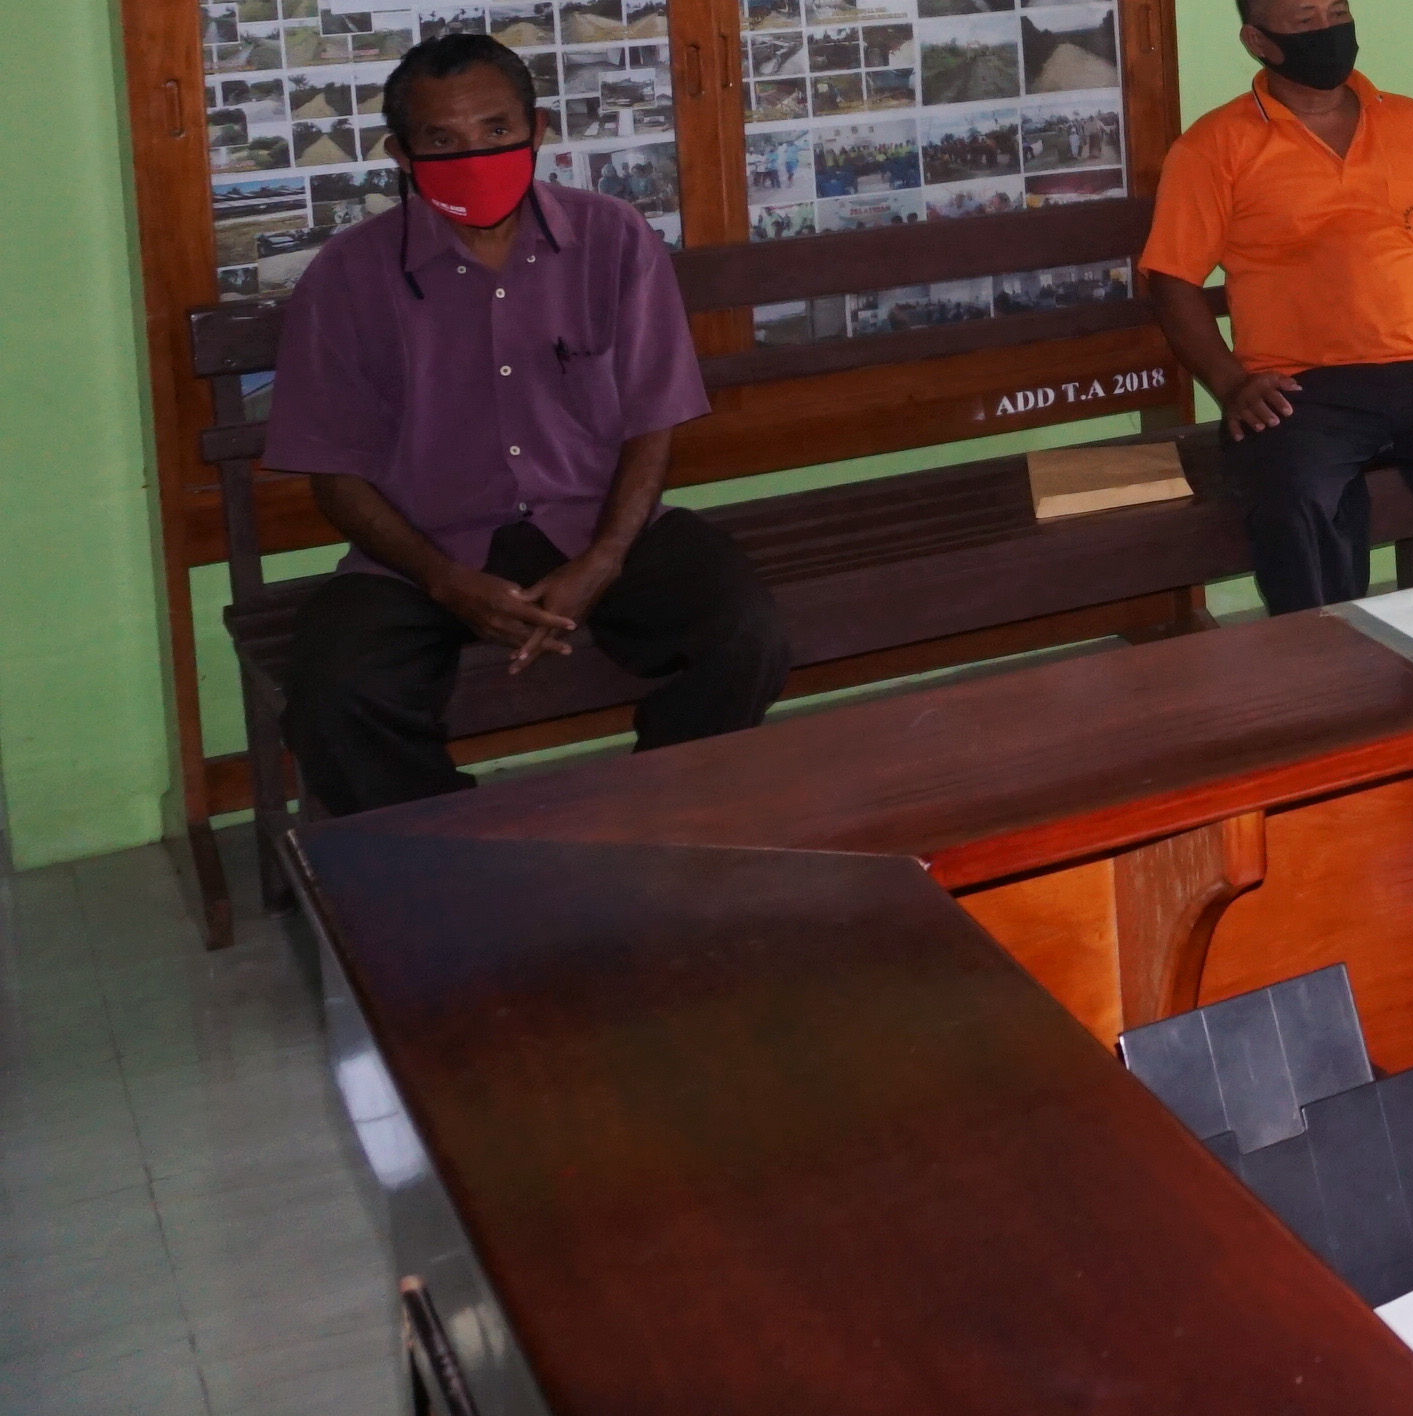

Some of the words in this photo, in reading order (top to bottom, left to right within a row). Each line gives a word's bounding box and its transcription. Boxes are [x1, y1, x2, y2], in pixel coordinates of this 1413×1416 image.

[995, 387, 1056, 416] ADD
[1061, 379, 1106, 403] T.A
[1113, 367, 1165, 395] 2018
